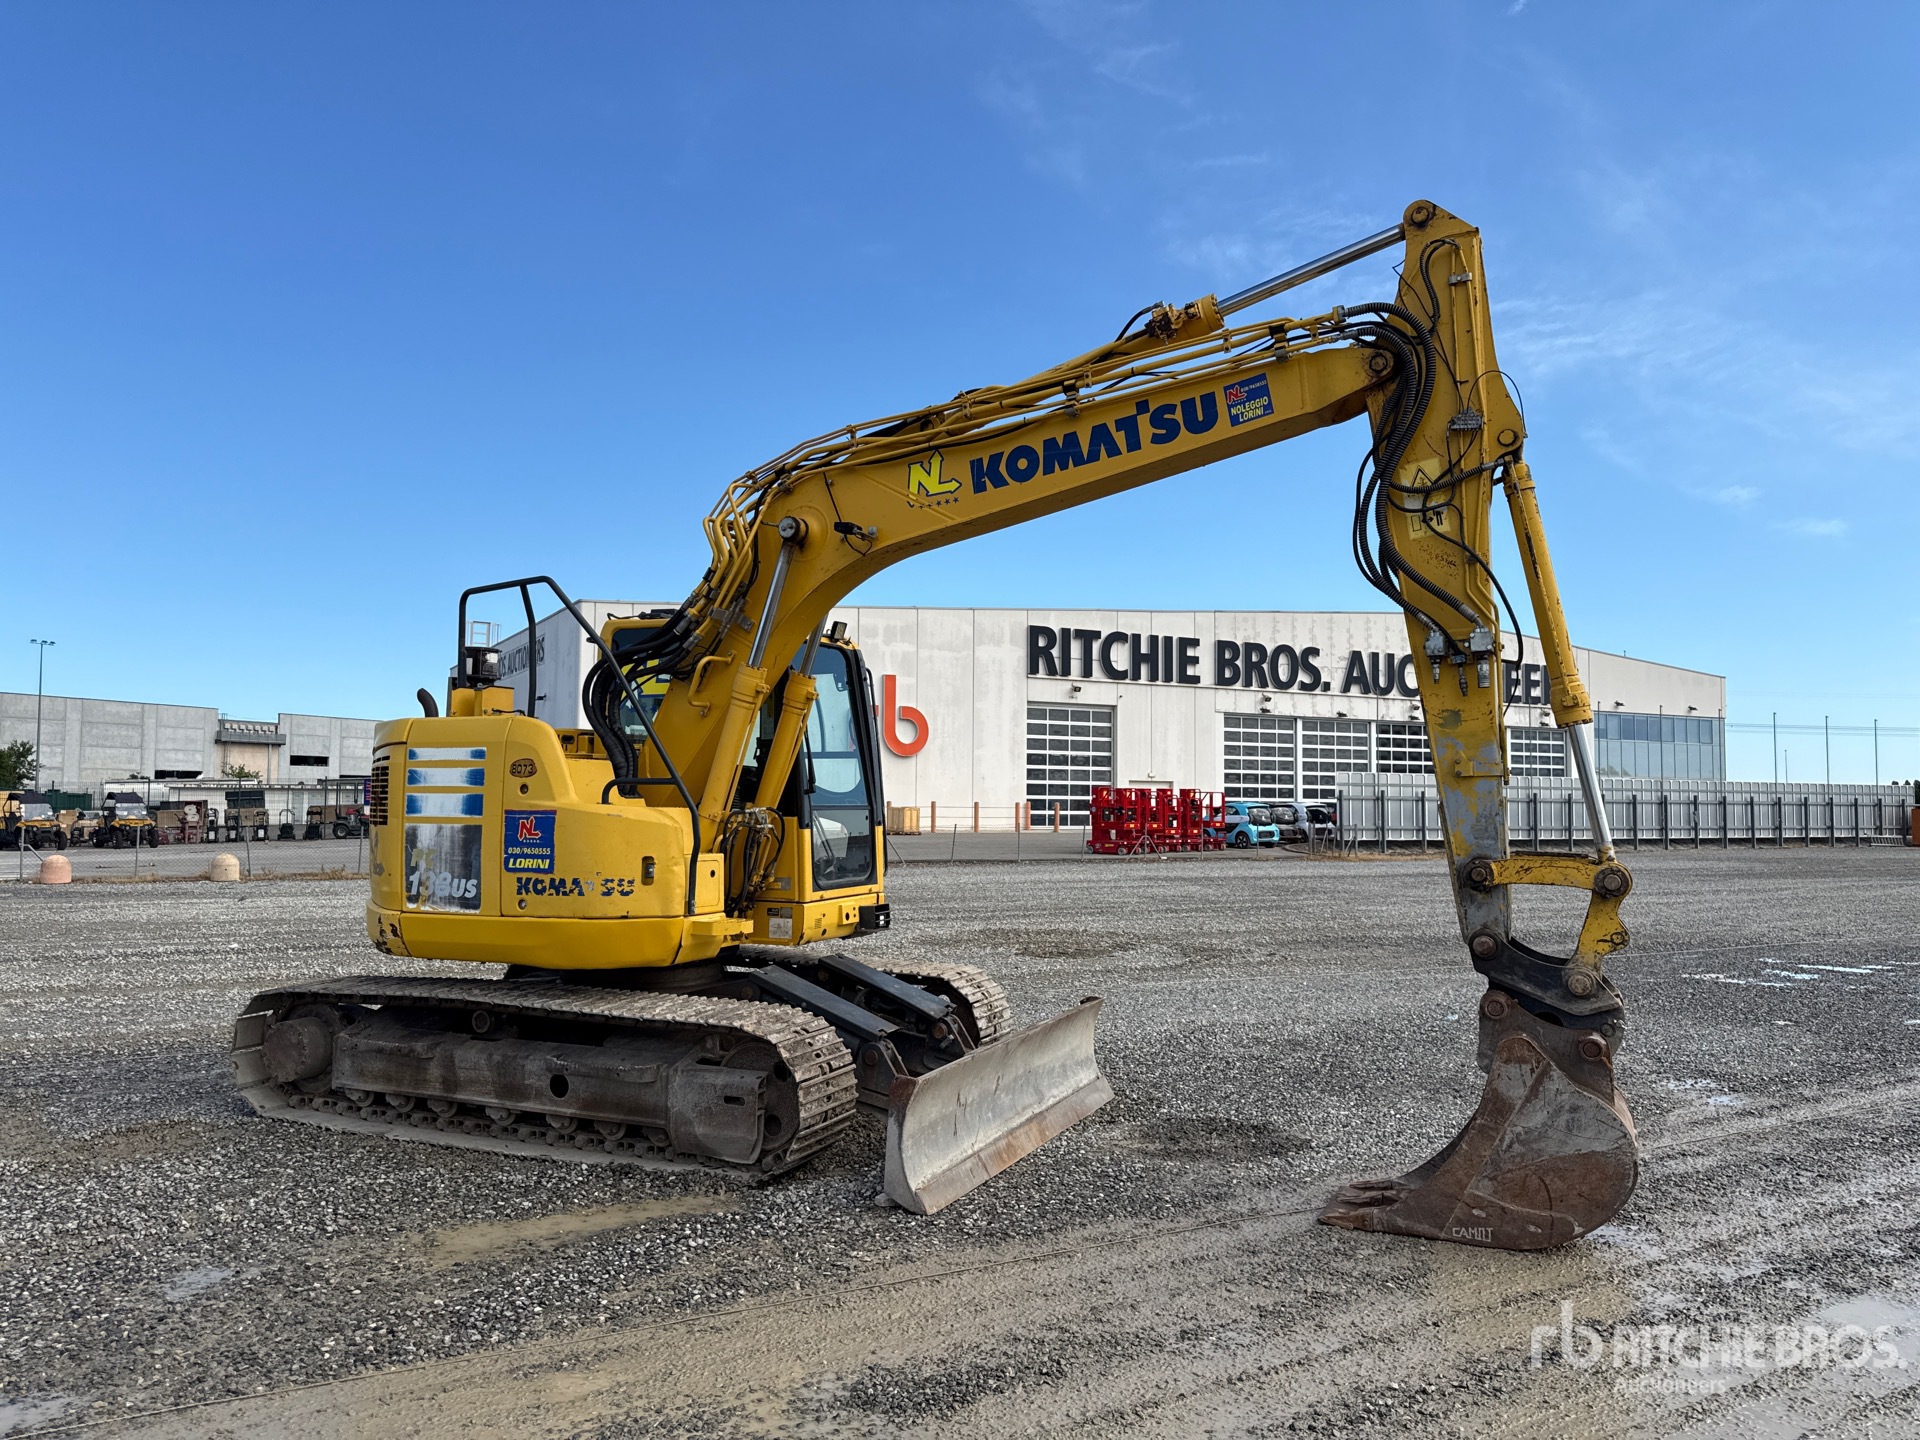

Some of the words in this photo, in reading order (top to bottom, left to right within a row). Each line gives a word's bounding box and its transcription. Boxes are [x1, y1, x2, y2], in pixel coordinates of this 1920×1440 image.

[1230, 396, 1269, 416] NOLEGGIO
[1238, 406, 1264, 422] LORINI
[969, 391, 1219, 495] KOMATSU
[1027, 624, 1201, 684] RITCHIE
[1214, 639, 1331, 692] BROS.
[511, 763, 534, 775] 8073
[507, 847, 551, 855] 030/9650555
[508, 858, 550, 870] LORINI
[516, 877, 635, 897] KOMASU
